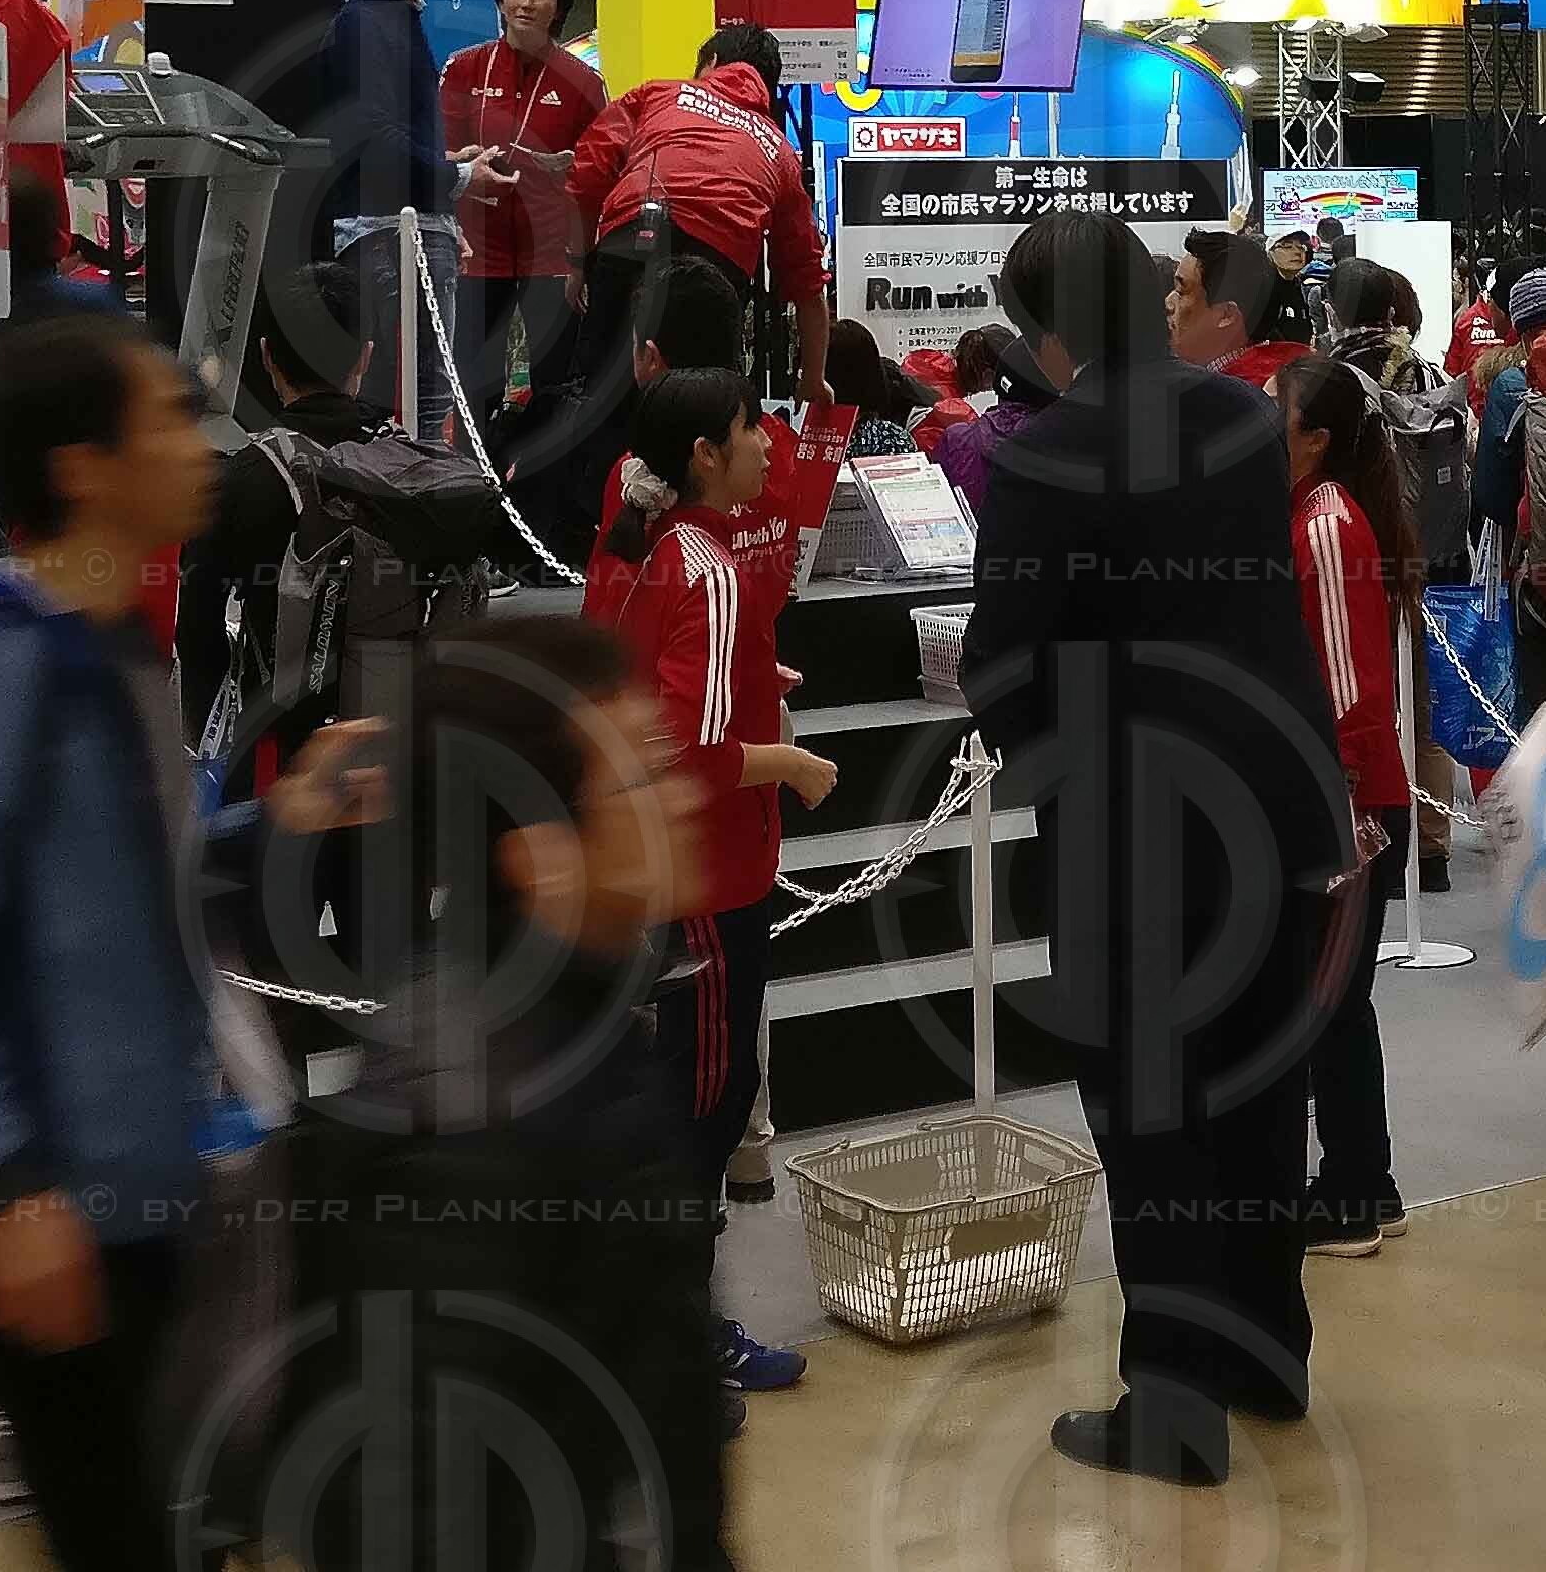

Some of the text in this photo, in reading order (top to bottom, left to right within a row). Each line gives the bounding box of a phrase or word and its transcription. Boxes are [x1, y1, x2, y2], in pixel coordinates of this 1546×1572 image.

[676, 93, 720, 116] Run
[880, 127, 958, 148] ヤマザキ
[994, 166, 1088, 190] 第一生命は
[881, 192, 1194, 218] 全国の市民マラソンを応援しています
[865, 274, 933, 312] Run
[936, 282, 989, 309] with
[1470, 326, 1496, 340] Run
